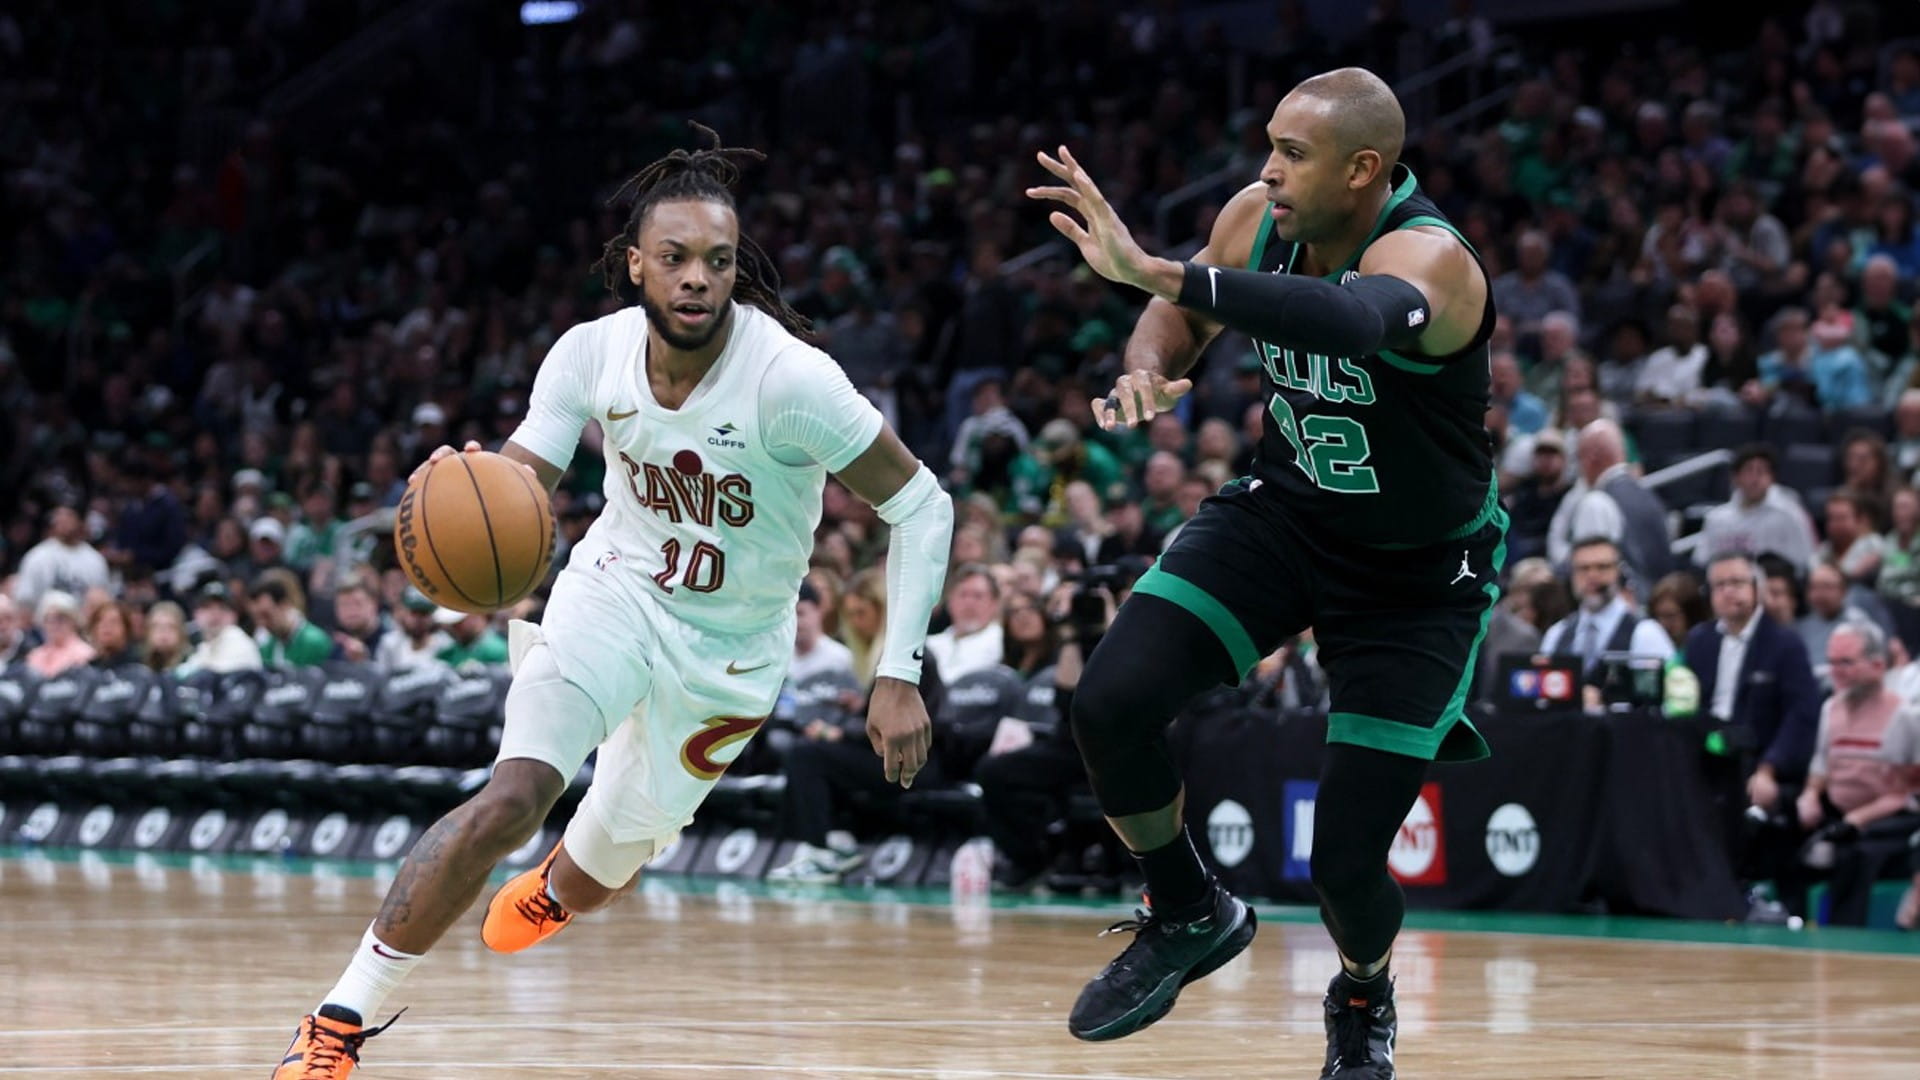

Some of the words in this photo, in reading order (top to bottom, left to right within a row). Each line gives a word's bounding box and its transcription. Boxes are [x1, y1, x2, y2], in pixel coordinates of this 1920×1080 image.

[707, 437, 746, 449] CLIFFS
[619, 451, 754, 527] CAVS
[648, 537, 725, 593] 10
[1486, 828, 1540, 853] TNT
